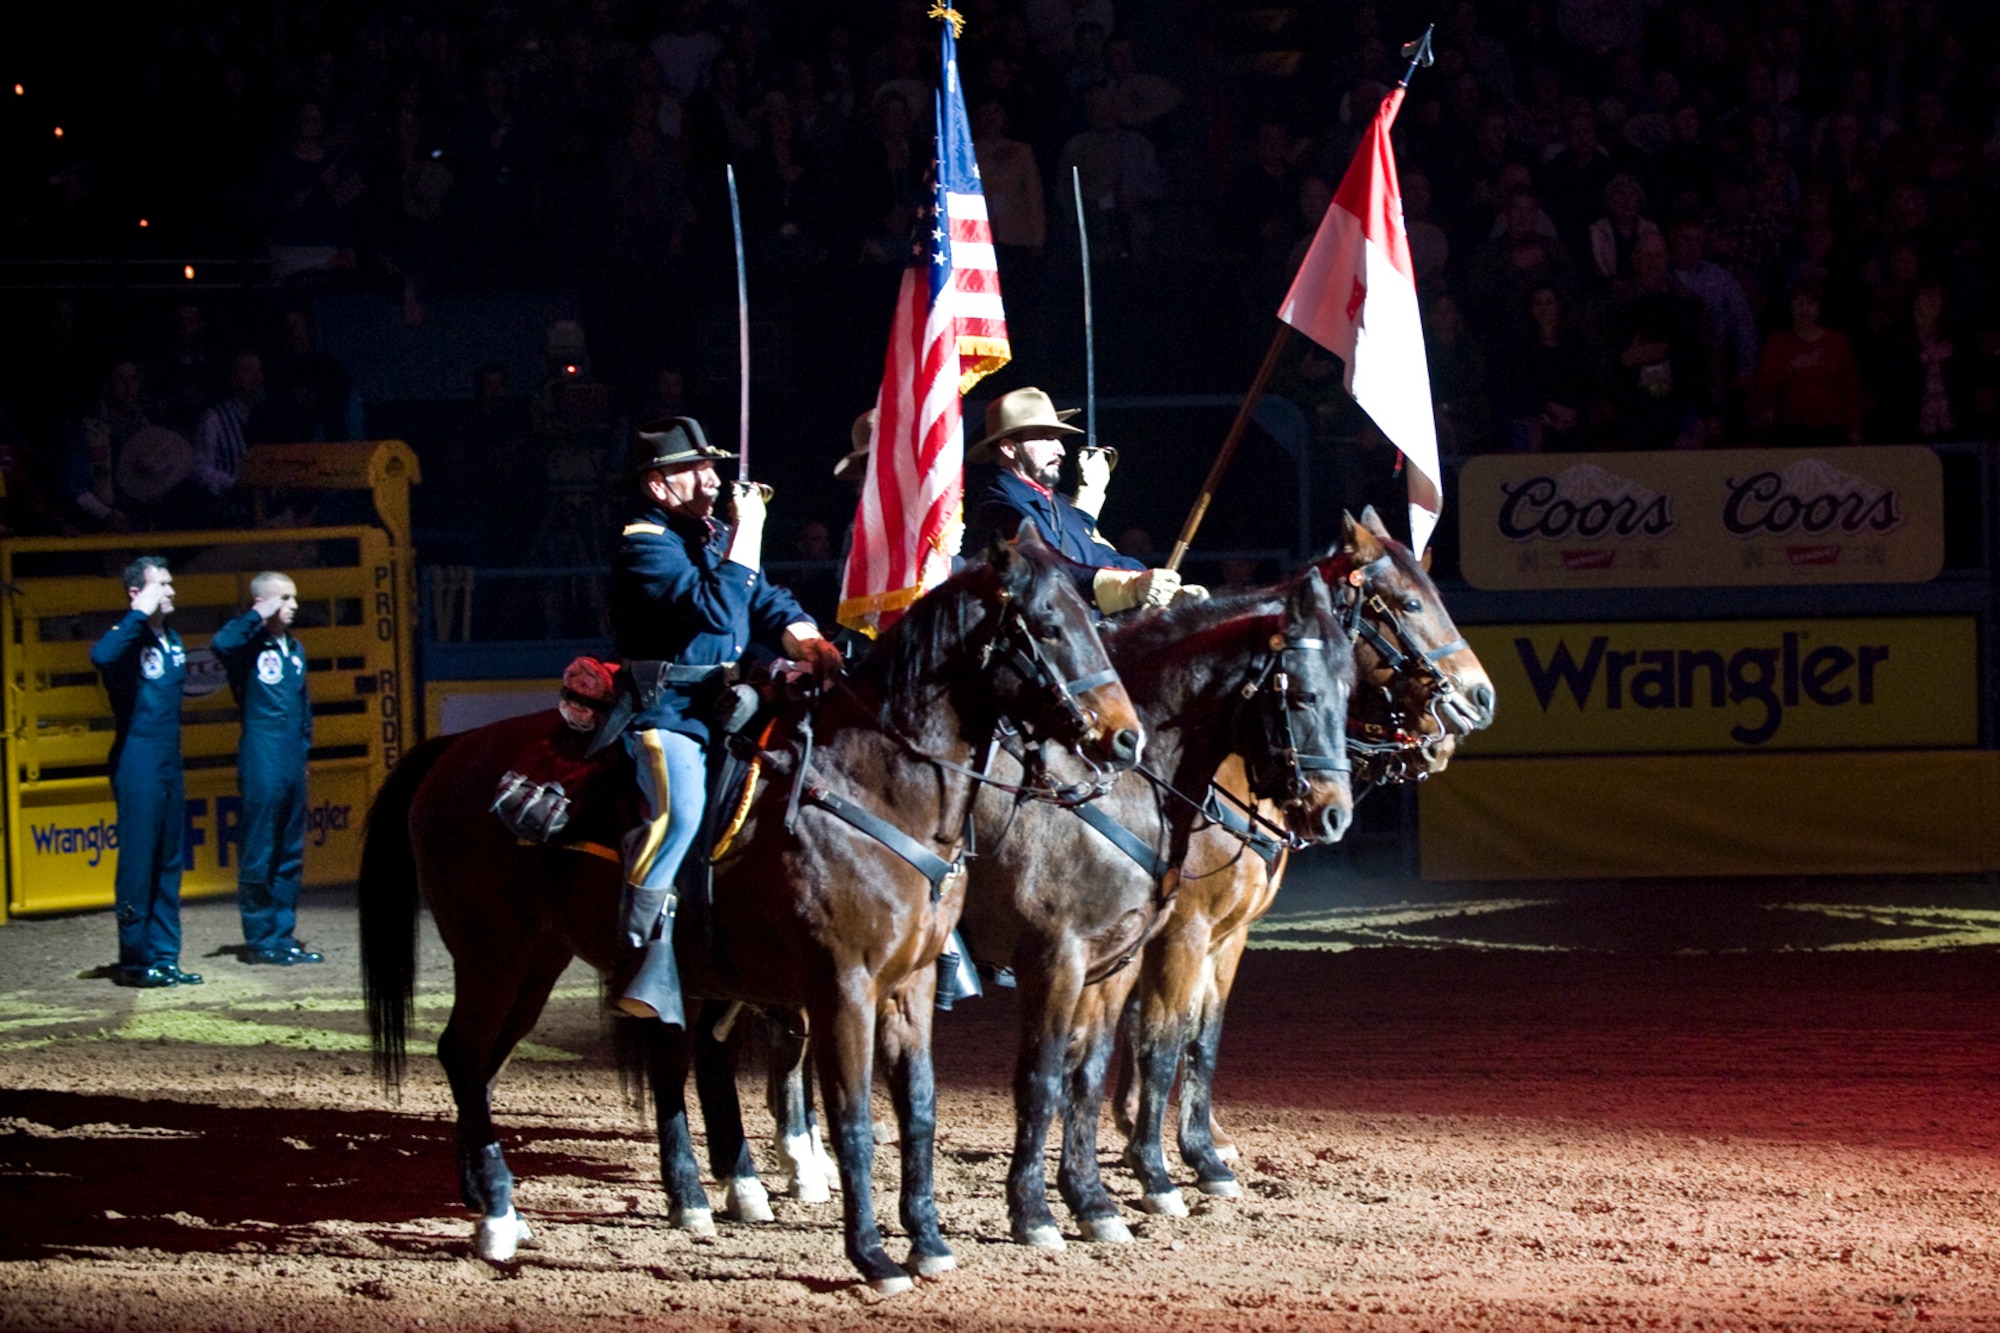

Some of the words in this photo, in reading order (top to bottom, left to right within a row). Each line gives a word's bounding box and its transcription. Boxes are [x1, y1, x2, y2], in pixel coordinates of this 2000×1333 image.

[1499, 477, 1672, 537] Coors
[1723, 473, 1898, 533] Coors
[374, 565, 392, 641] PRO
[379, 670, 397, 769] RODE
[1514, 632, 1889, 743] Wrangler
[31, 819, 119, 867] Wrangle
[183, 797, 243, 870] FR
